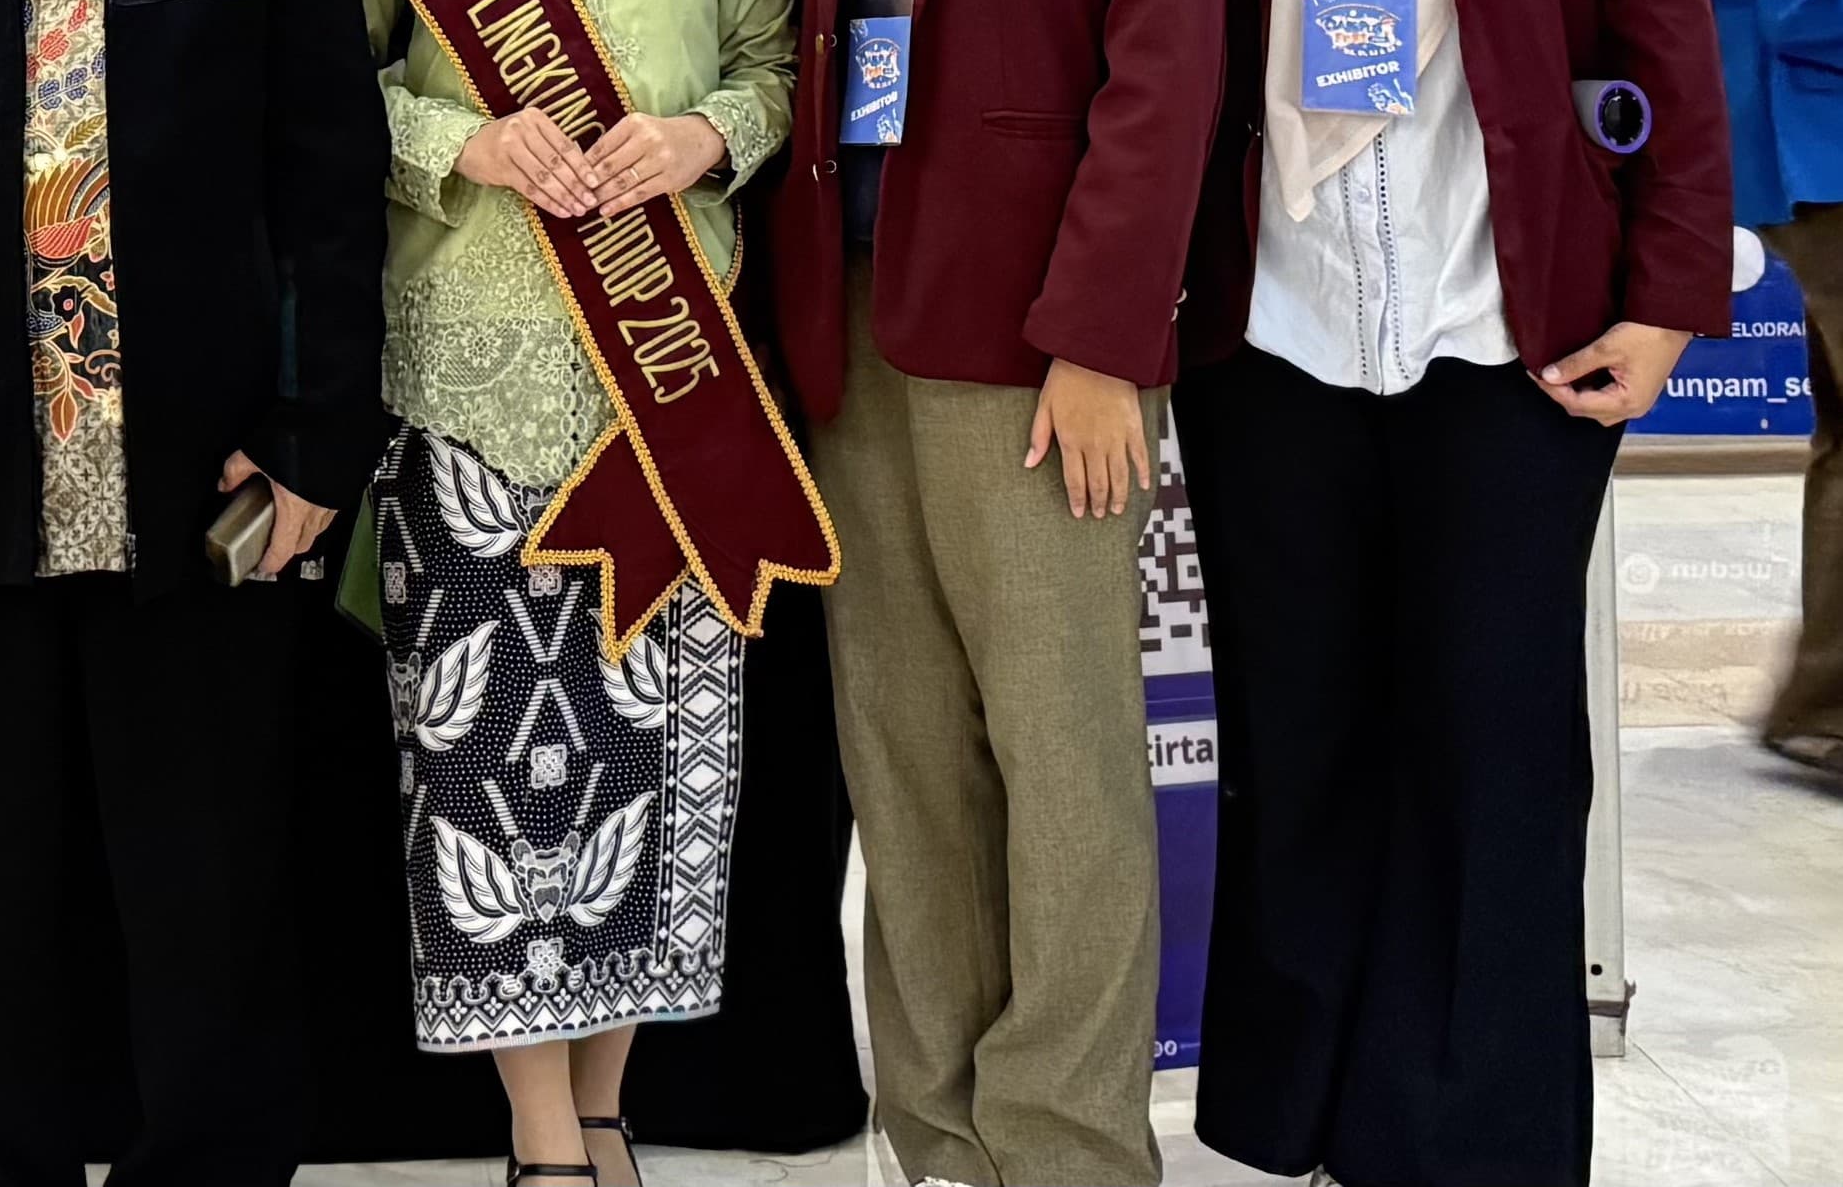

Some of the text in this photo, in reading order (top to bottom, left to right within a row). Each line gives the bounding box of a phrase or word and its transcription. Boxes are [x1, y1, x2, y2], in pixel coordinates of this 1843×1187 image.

[1316, 60, 1400, 87] EXHIBITOR
[1732, 322, 1807, 337] ELODRA
[617, 296, 720, 404] 2025
